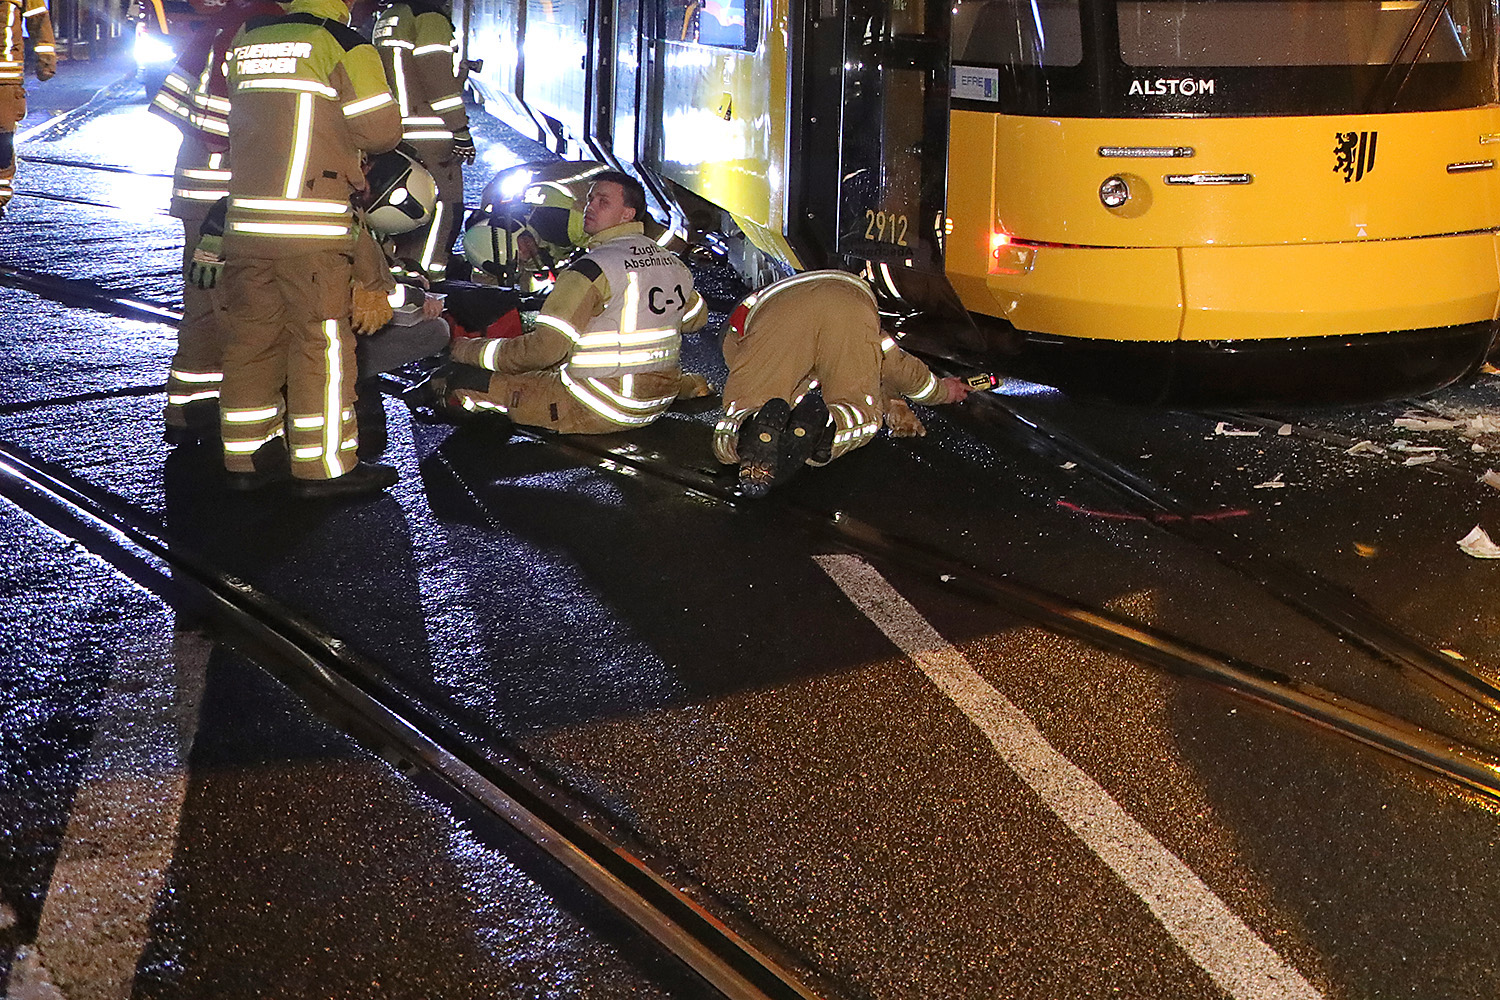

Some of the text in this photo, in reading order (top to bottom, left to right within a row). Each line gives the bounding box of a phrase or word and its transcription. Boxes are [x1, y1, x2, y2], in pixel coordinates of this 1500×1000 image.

[1128, 78, 1215, 96] ALSTOM
[865, 209, 908, 247] 2912
[648, 284, 686, 315] C-1
